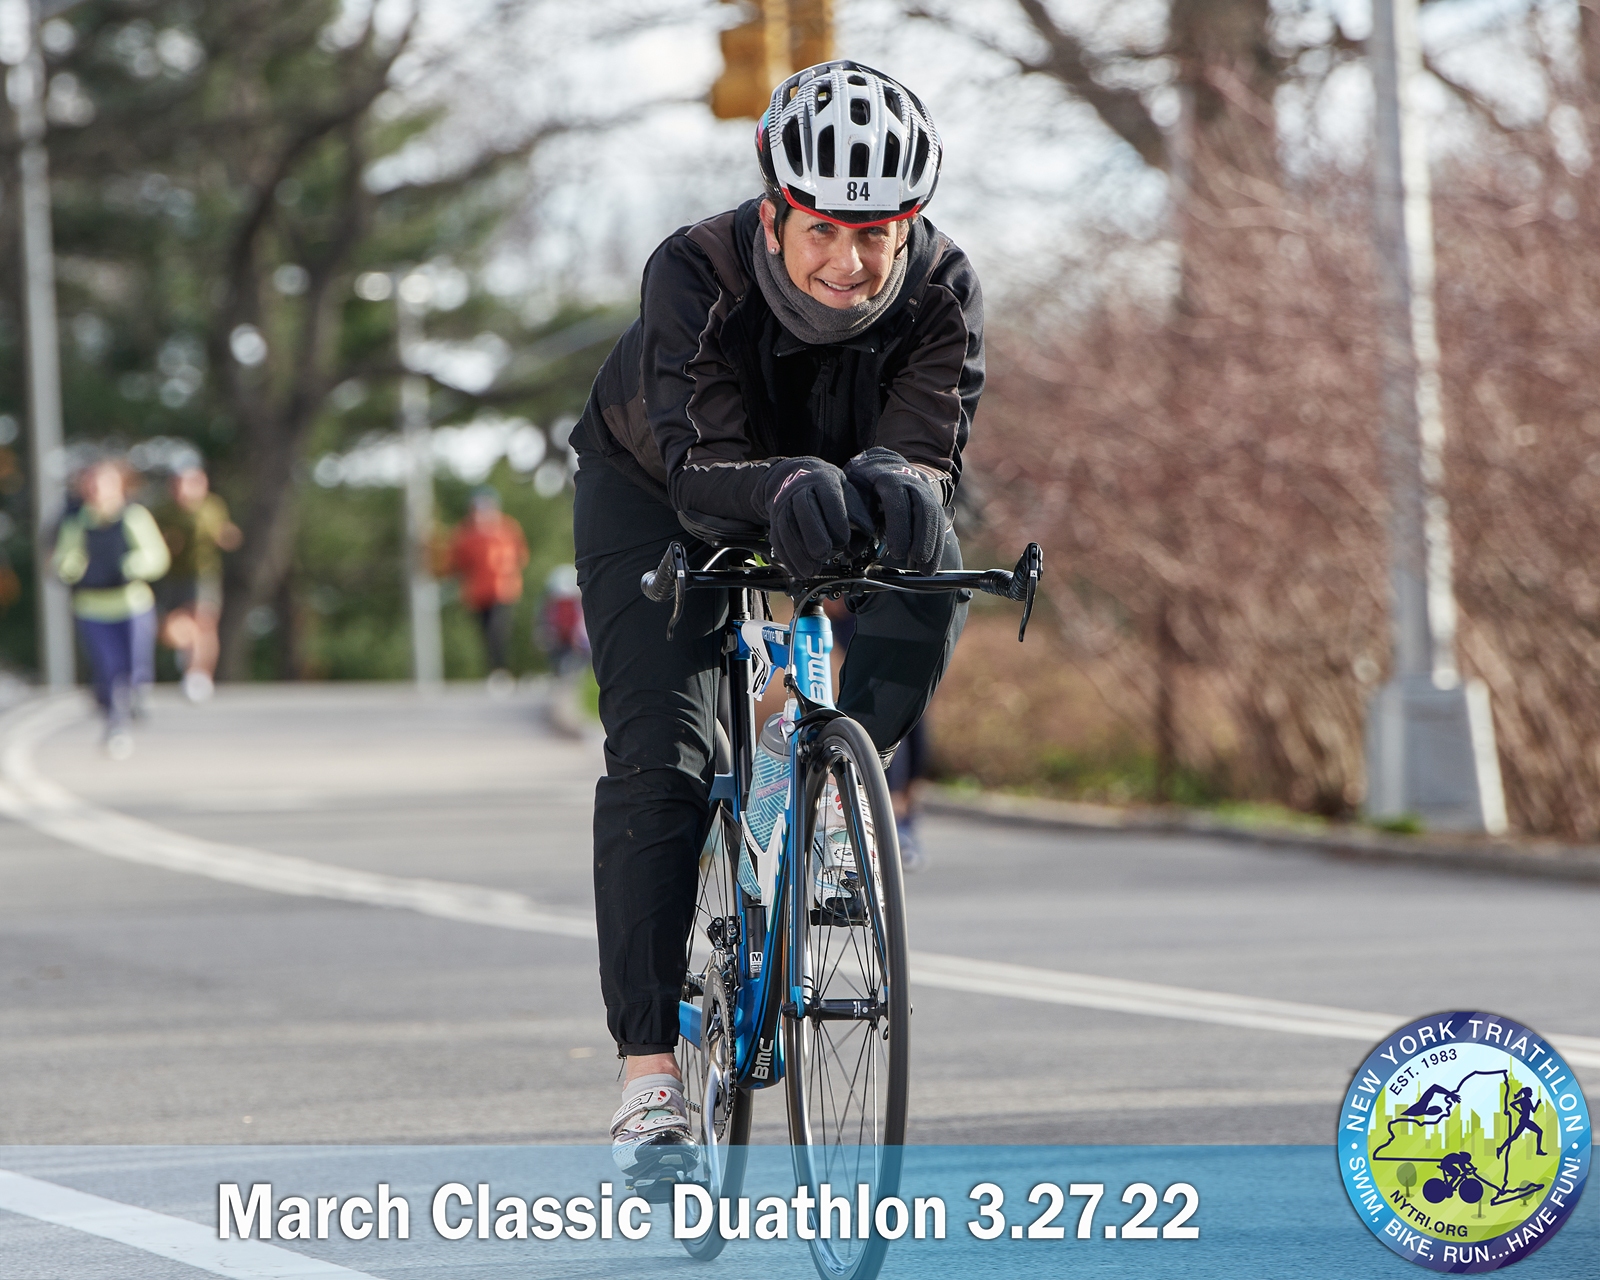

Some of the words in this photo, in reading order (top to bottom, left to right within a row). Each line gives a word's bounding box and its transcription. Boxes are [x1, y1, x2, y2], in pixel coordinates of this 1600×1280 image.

[846, 181, 870, 201] 84
[806, 634, 827, 703] BMC
[752, 1037, 774, 1080] BMC
